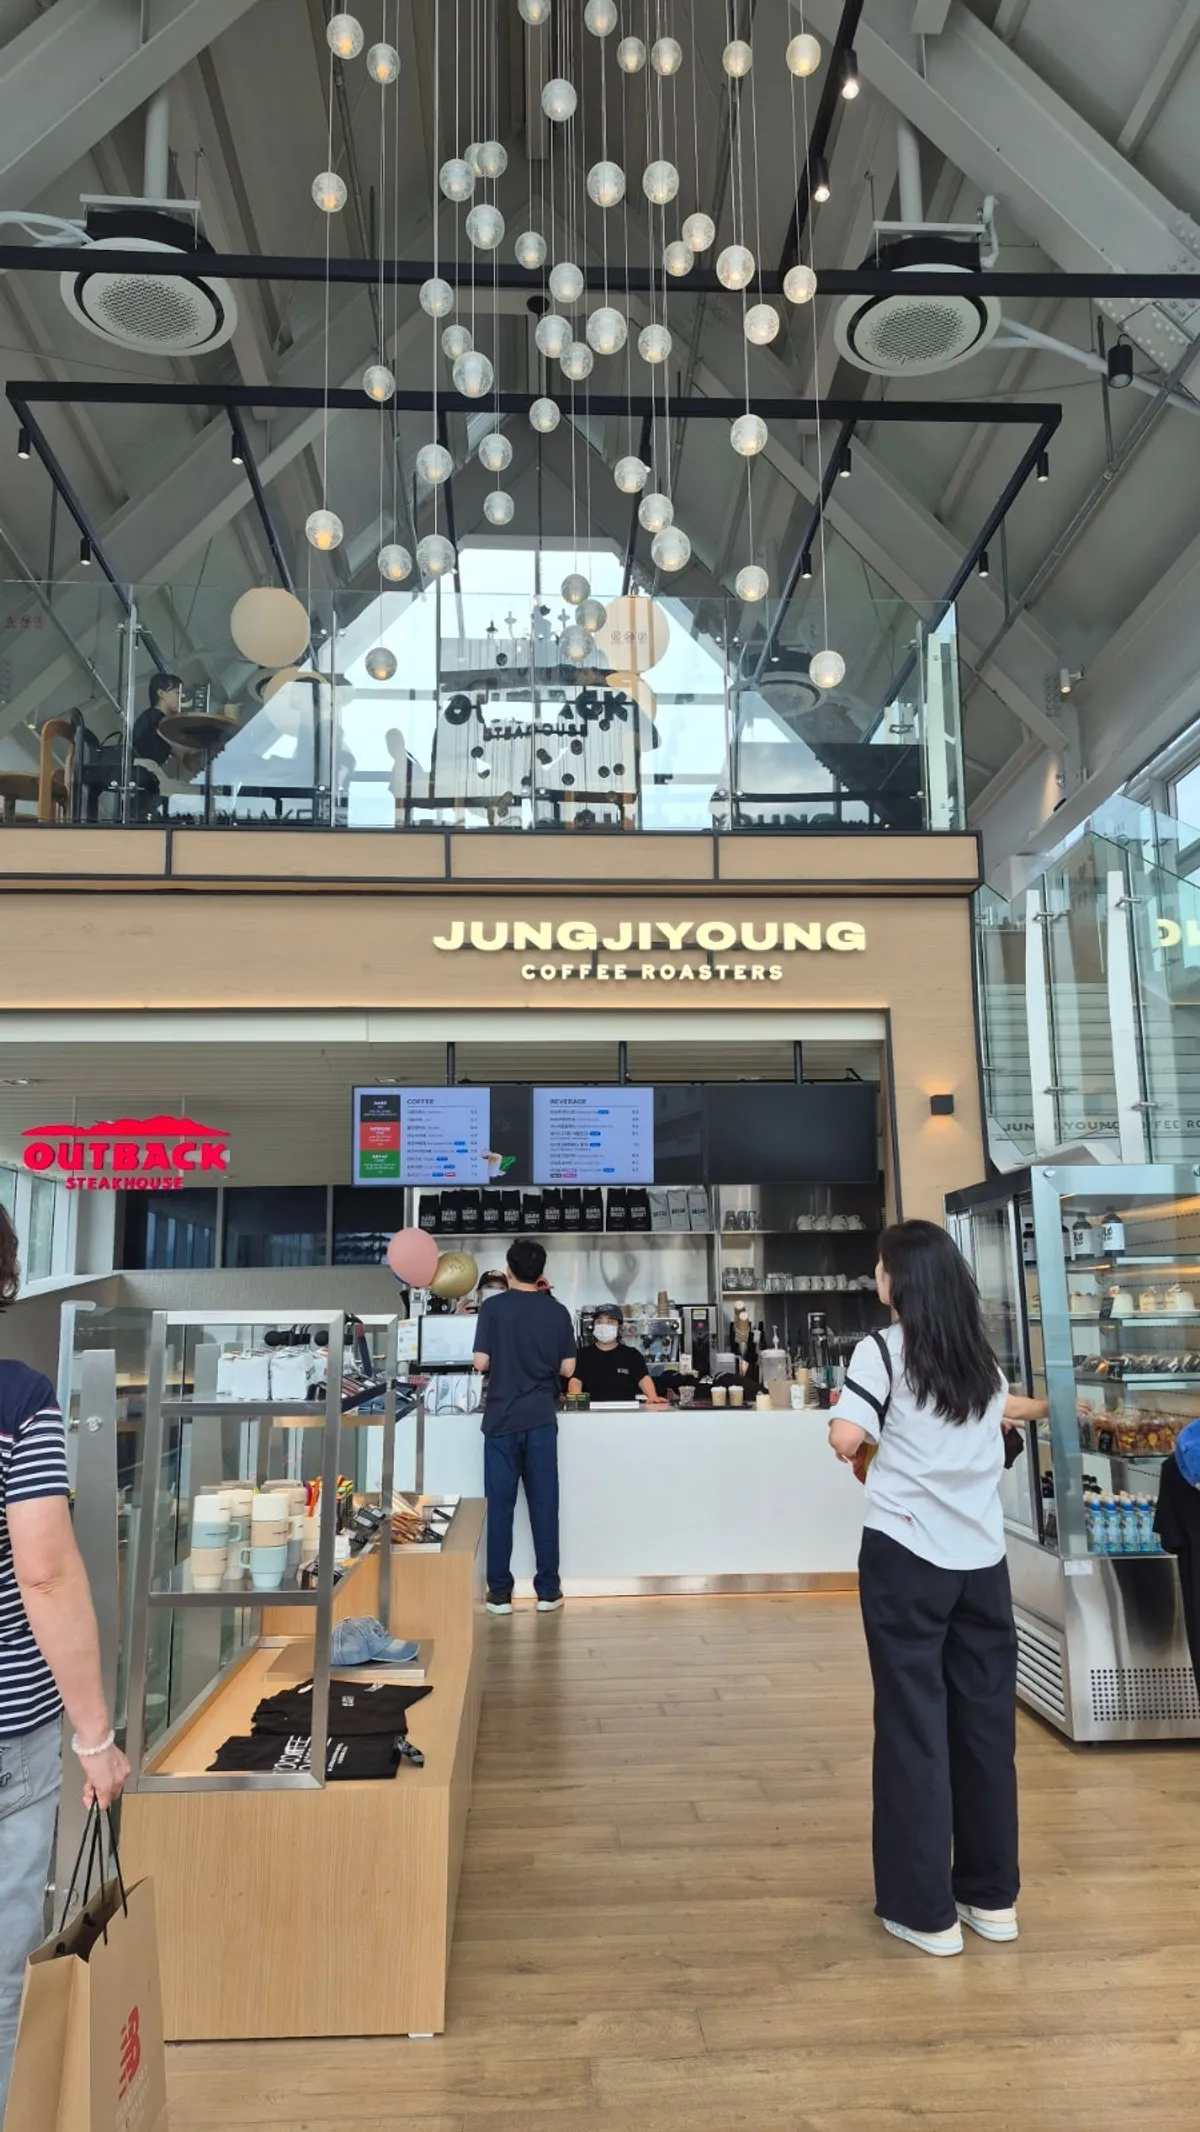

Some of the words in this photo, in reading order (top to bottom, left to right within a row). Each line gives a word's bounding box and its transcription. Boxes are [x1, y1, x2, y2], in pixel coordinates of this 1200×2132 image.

[433, 921, 866, 950] JUNGJIYOUNG
[521, 964, 627, 981] COFFEE
[641, 964, 784, 981] ROASTERS
[23, 1141, 227, 1171] OUTBACK
[65, 1176, 185, 1191] STEAKHOUSE
